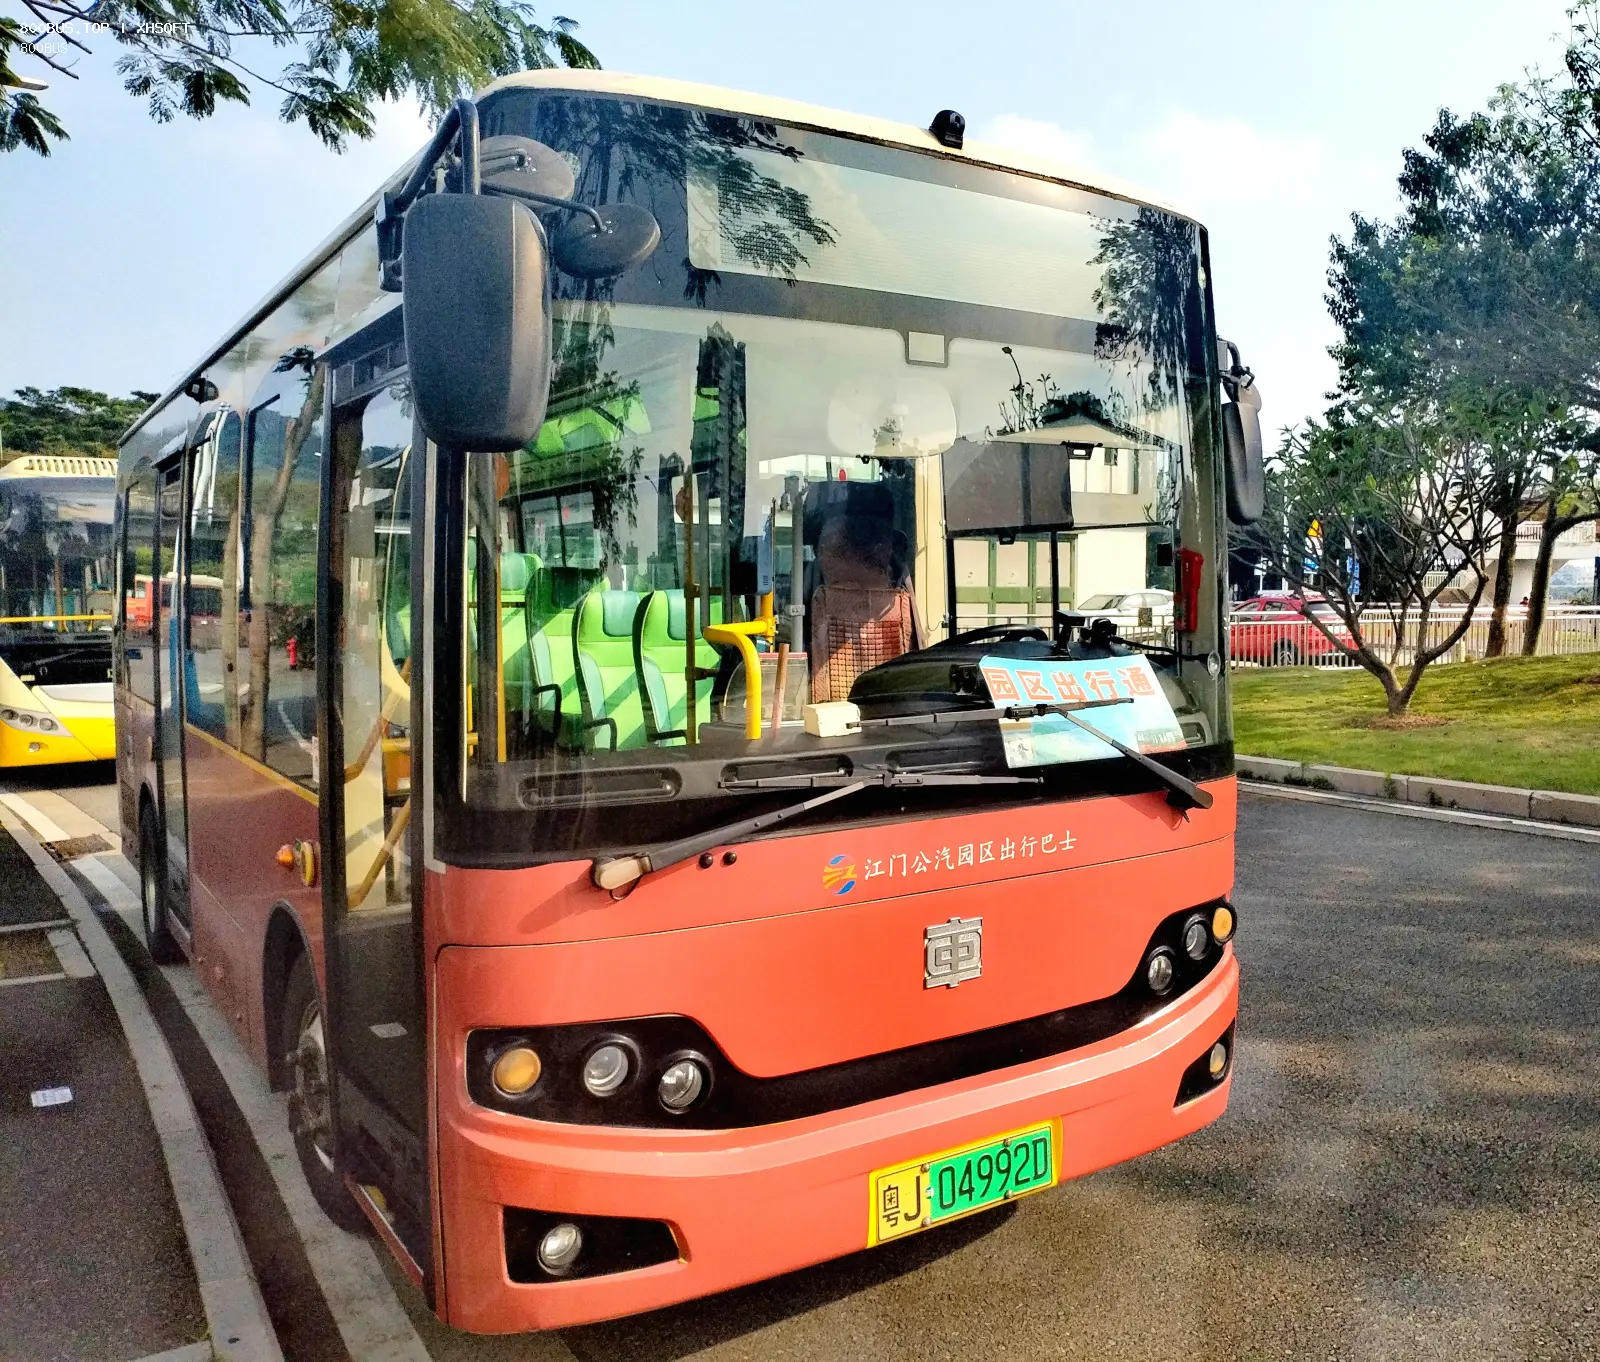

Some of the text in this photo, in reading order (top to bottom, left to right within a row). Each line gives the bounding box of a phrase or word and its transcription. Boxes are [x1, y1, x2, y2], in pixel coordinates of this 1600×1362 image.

[981, 666, 1156, 702] 园区出行通
[863, 830, 1078, 881] 江门公汽园区出行巴士
